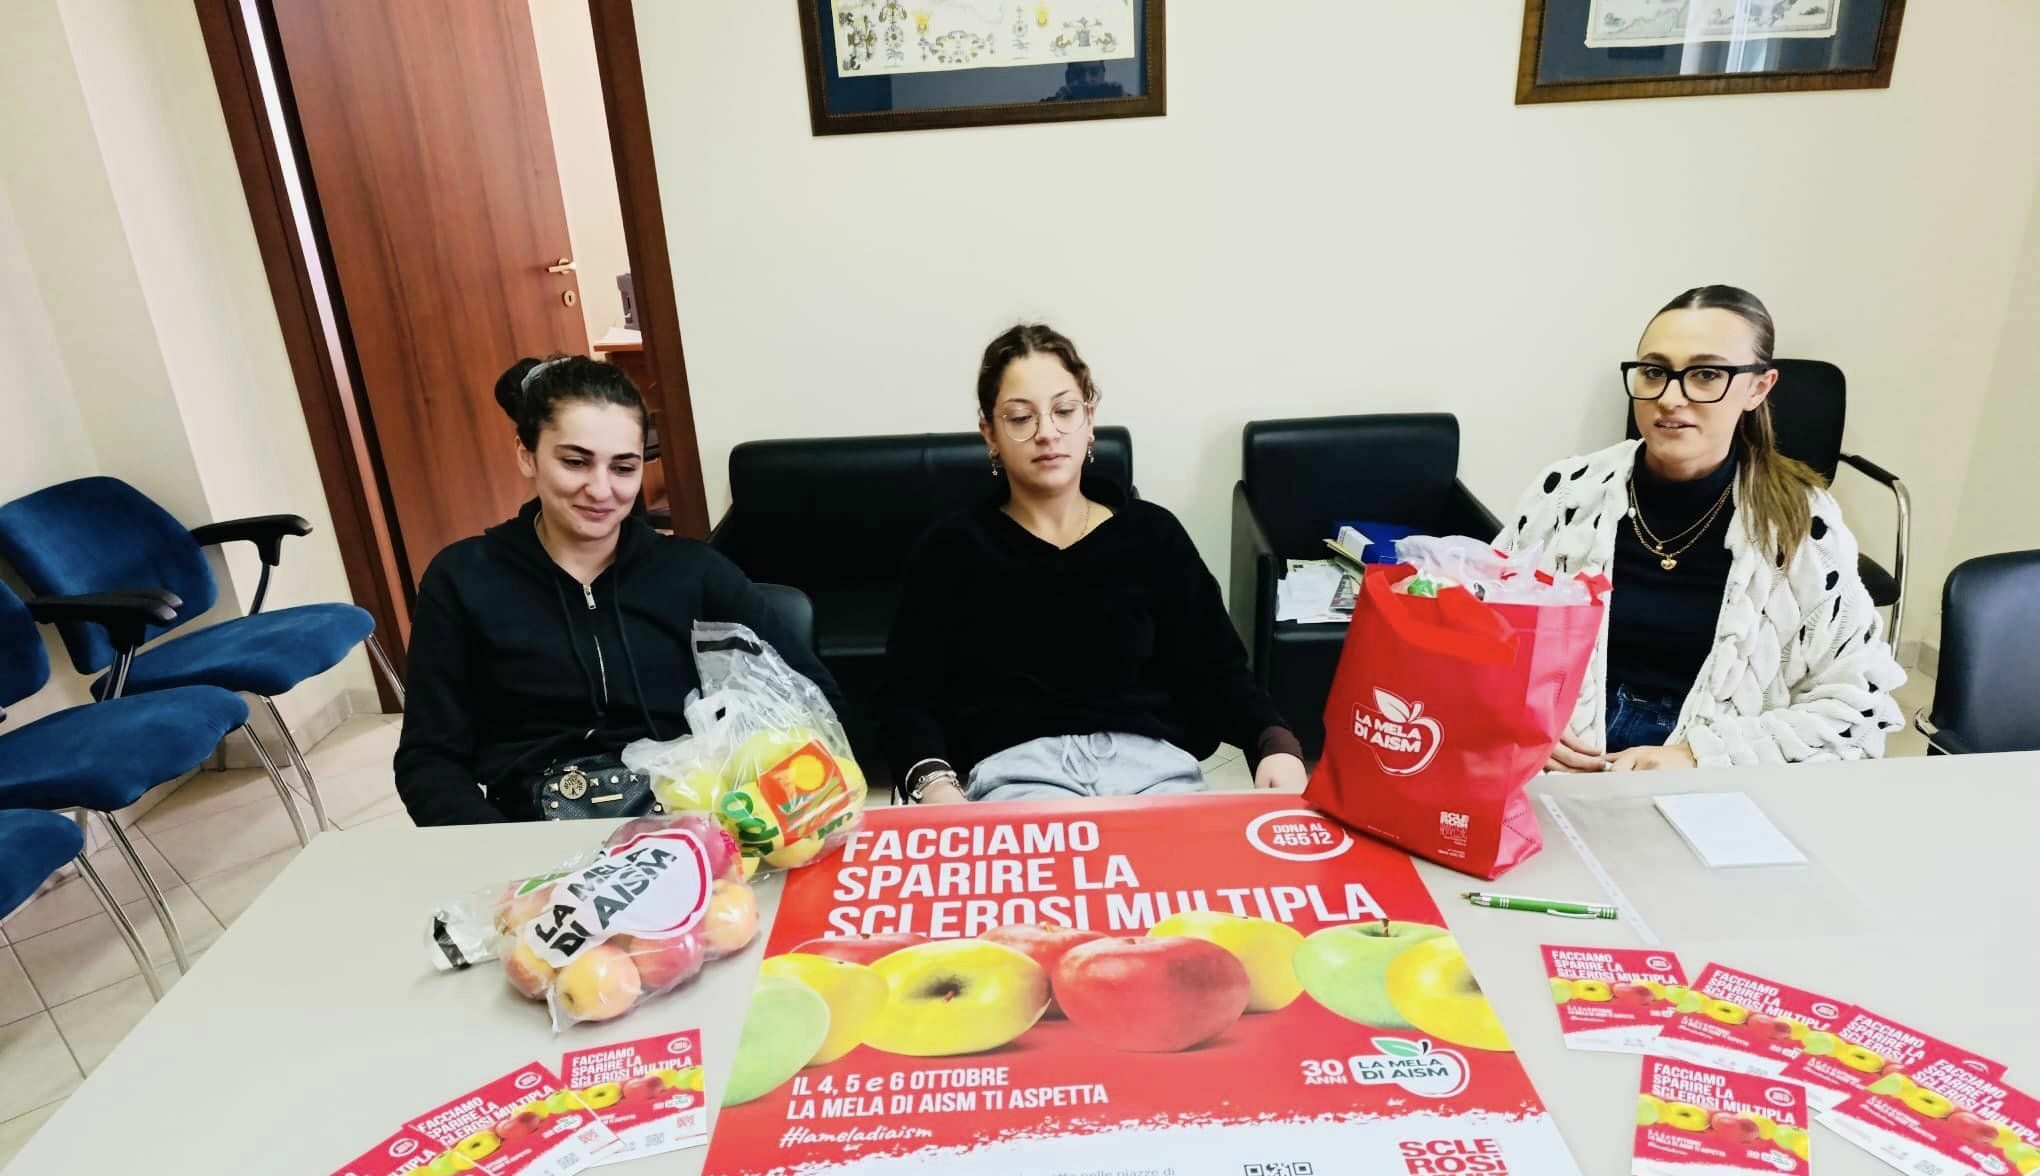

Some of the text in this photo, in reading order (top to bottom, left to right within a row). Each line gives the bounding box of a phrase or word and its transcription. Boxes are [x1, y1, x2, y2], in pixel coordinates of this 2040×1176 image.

[1354, 709, 1421, 740] LA MELA
[1354, 721, 1422, 753] DI AISM
[844, 821, 1099, 862] FACCIAMO
[1272, 822, 1325, 835] DONA AL
[1273, 831, 1334, 846] 45512
[834, 854, 1139, 900] SPARIRE LA
[535, 847, 649, 943] LA MELA
[550, 848, 677, 957] DI AISM
[824, 883, 1386, 938] SCLEROSI MULTIPLA
[1551, 950, 1613, 963] FACCIAMO
[1554, 959, 1624, 973] SPARIRE LA
[1557, 969, 1678, 985] SCLEROSI MULTIPLA
[1707, 977, 1782, 1008] SPARIRE LA
[1712, 969, 1780, 996] FACCIAMO
[1702, 985, 1764, 1013] SCLEROSI
[1846, 1022, 1926, 1060] SPARIRE LA
[1854, 1014, 1926, 1048] FACCIAMO
[572, 1047, 635, 1068] FACCIAMO
[1838, 1029, 1906, 1065] SCLEROSI
[570, 1056, 693, 1089] SCLEROSI MULTIPLA
[571, 1056, 642, 1078] SPARIRE LA
[1302, 1060, 1344, 1077] 30
[1304, 1074, 1347, 1085] ANNI
[1357, 1058, 1444, 1070] LA MELA
[1361, 1066, 1449, 1080] DI AISM
[1654, 1063, 1726, 1088] FACCIAMO
[1934, 1059, 2007, 1098] FACCIAMO
[792, 1067, 1009, 1098] IL 4, 5 e 6 OTTOBRE
[1652, 1074, 1734, 1100] SPARIRE LA
[1924, 1066, 2004, 1112] SPARIRE LA
[416, 1097, 484, 1133] FACCIAMO
[439, 1084, 555, 1148] CLEROSI MULTIPLA
[479, 1101, 500, 1117] LA
[786, 1084, 1109, 1120] LA MELA DI AISM TI ASPETTA
[1652, 1085, 1795, 1125] SCLEROSI MULTIPLA
[1911, 1072, 1980, 1112] SCLEROSI
[1976, 1106, 2040, 1146] MULTIPL
[779, 1125, 932, 1148] #lameladiaism
[1399, 1139, 1499, 1157] SCLE
